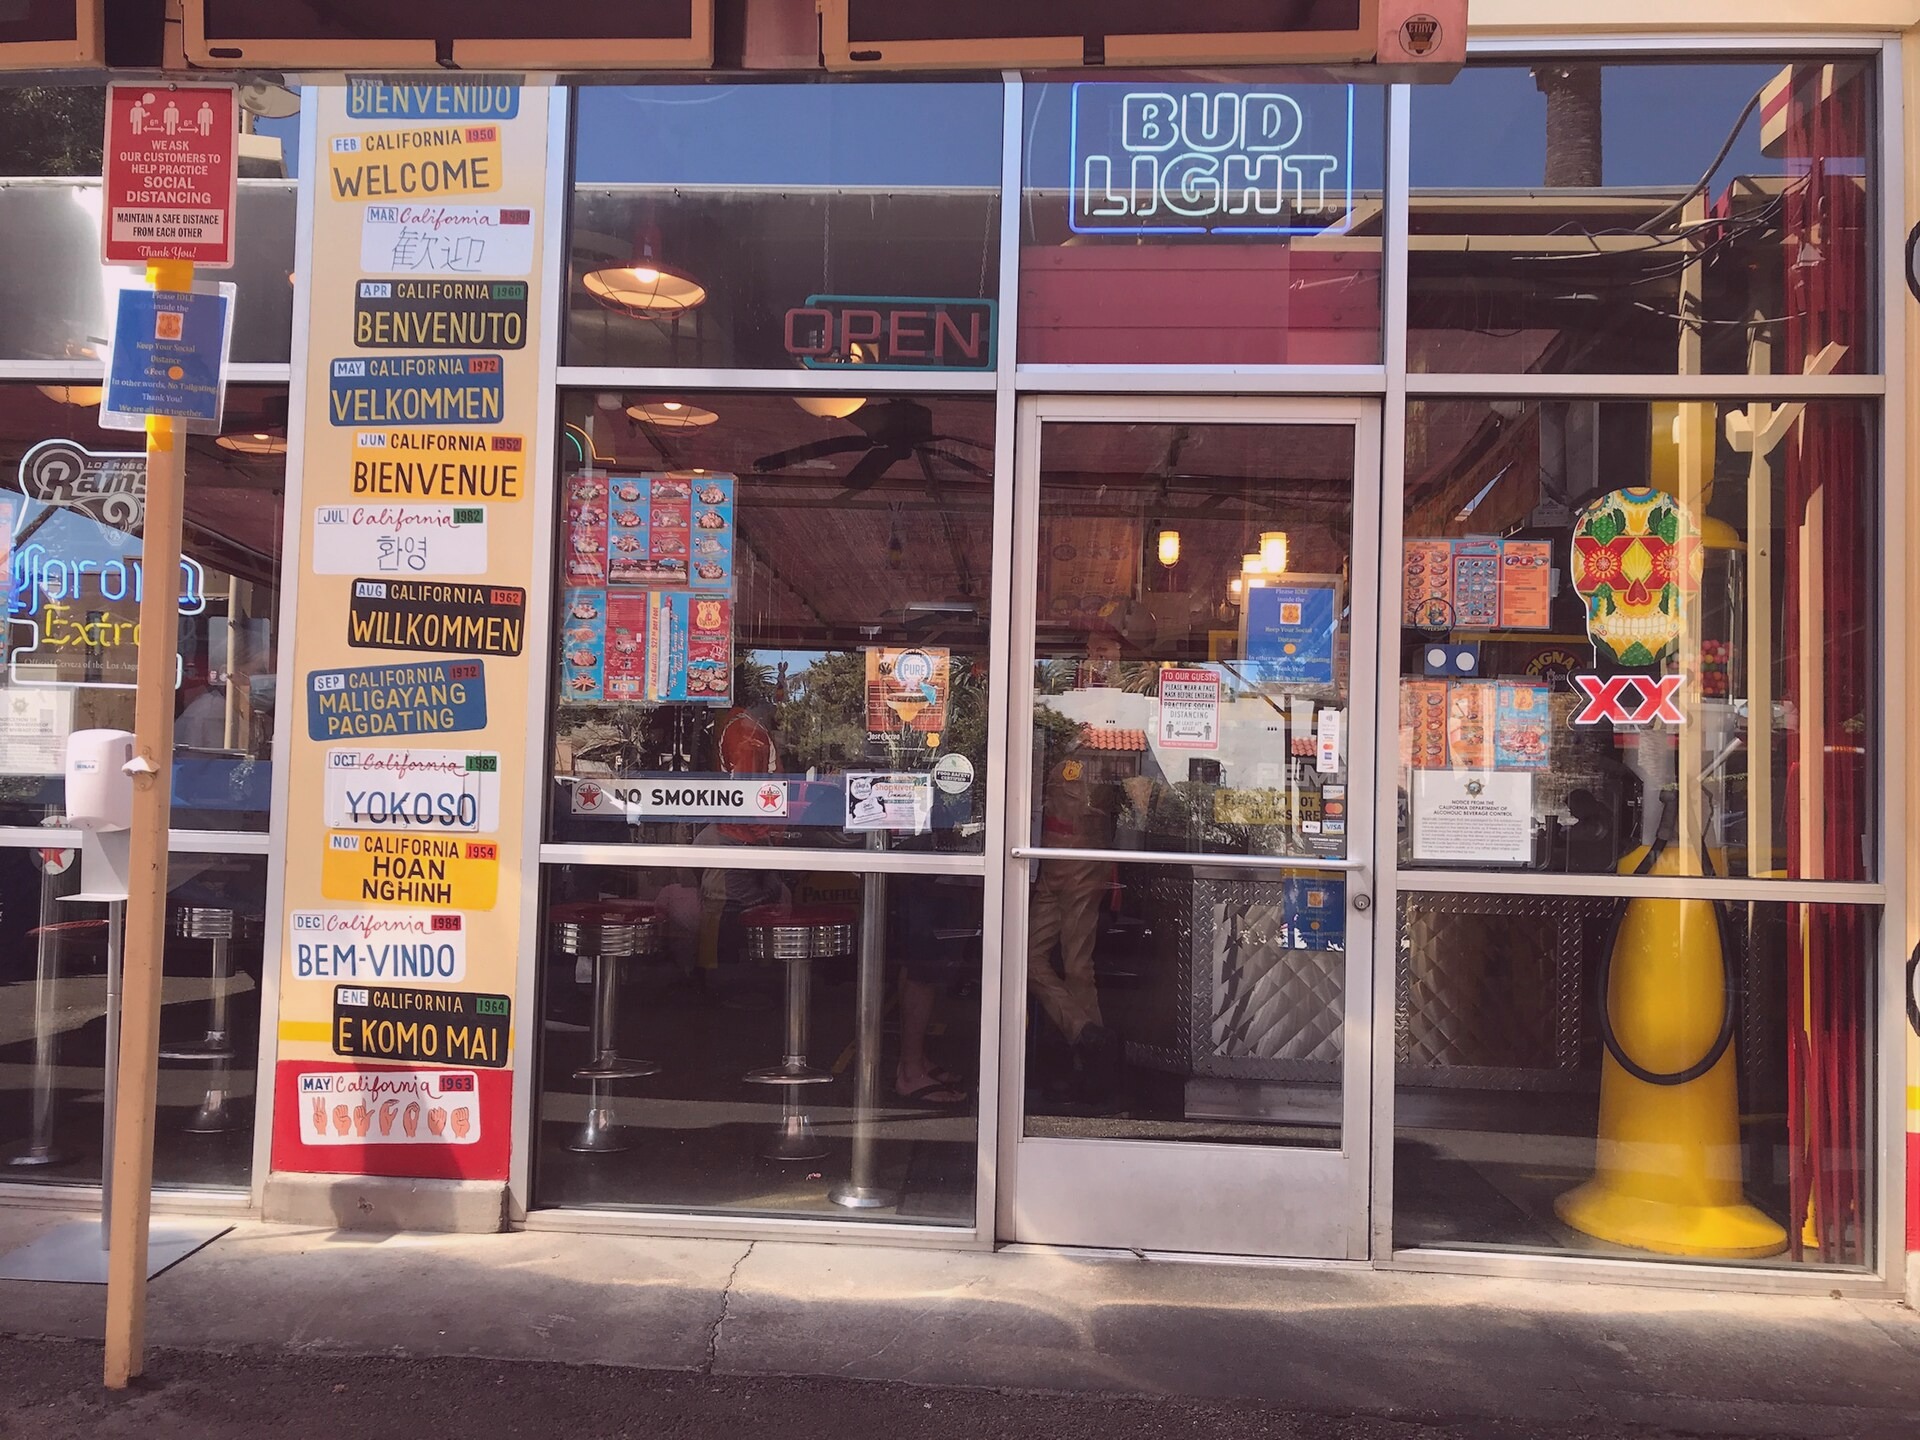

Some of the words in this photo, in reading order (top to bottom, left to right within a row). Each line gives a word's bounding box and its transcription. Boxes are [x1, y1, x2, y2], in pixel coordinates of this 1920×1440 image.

[1408, 22, 1434, 33] ETHYL
[351, 85, 511, 114] BIENVENIDO
[1122, 92, 1303, 152] BUD
[152, 140, 168, 150] WE
[169, 140, 190, 151] ASK
[336, 138, 356, 151] FEB
[366, 129, 462, 152] CALIFORNIA
[468, 129, 494, 141] 1950
[120, 152, 141, 162] OUR
[143, 152, 206, 163] CUSTOMERS
[208, 154, 221, 164] TO
[131, 165, 156, 175] HELP
[159, 165, 208, 176] PRACTICE
[333, 157, 490, 198] WELCOME
[143, 176, 195, 190] SOCIAL
[1084, 152, 1338, 216] LIGHT
[126, 191, 212, 204] DISTANCING
[117, 212, 153, 224] MAINTAIN
[154, 213, 160, 224] A
[162, 214, 180, 224] SAFE
[182, 214, 219, 225] DISTANCE
[370, 208, 395, 222] MAR
[400, 207, 498, 231] California
[132, 226, 154, 236] FROM
[156, 226, 176, 238] EACH
[178, 227, 202, 238] OTHER
[138, 246, 170, 258] Thank
[170, 246, 196, 260] You!
[364, 284, 388, 297] APR
[397, 284, 489, 300] CALIFORNIA
[496, 287, 522, 298] 1960
[176, 304, 189, 312] the
[357, 311, 521, 344] BENVENUTO
[784, 308, 980, 358] OPEN
[136, 341, 153, 351] Keep
[155, 342, 172, 351] Your
[150, 368, 166, 376] Feet
[337, 362, 362, 374] MAY
[369, 358, 464, 376] CALIFORNIA
[472, 360, 496, 372] 1972
[121, 379, 141, 387] other
[142, 392, 164, 401] Thank
[166, 394, 182, 403] You!
[332, 388, 499, 421] VELKOMMEN
[360, 434, 386, 446] JUN
[390, 434, 486, 451] CALIFORNIA
[494, 438, 520, 450] 1952
[87, 461, 110, 469] LOS
[112, 462, 146, 470] ANGE
[354, 461, 518, 498] BIENVENUE
[323, 509, 344, 522] JUL
[352, 508, 460, 532] California
[456, 510, 480, 522] 1982
[376, 535, 428, 571] 환영
[7, 543, 198, 616] Coroa
[358, 584, 383, 597] AUG
[390, 584, 484, 604] CALIFORNIA
[494, 592, 519, 603] 1962
[41, 604, 140, 647] Extr
[352, 610, 520, 652] WILLKOMMEN
[82, 660, 90, 668] of
[92, 660, 104, 669] the
[106, 660, 118, 670] Los
[903, 664, 926, 676] PURE
[1526, 651, 1576, 676] SIGNA
[317, 677, 340, 690] SEP
[349, 666, 446, 688] CALIFORNIA
[452, 666, 476, 678] 1972
[1164, 672, 1173, 680] TO
[1175, 672, 1190, 680] OUR
[1191, 673, 1217, 681] GUESTS
[1202, 684, 1215, 692] FACE
[320, 683, 466, 715] MALIGAYANG
[1164, 702, 1191, 710] PRACTICE
[1194, 692, 1216, 700] ENTERING
[1574, 674, 1688, 725] XX
[328, 708, 454, 736] PAGDATING
[1170, 711, 1209, 719] DISTANCING
[333, 755, 356, 767] OCT
[362, 754, 470, 779] California
[468, 757, 496, 770] 1982
[346, 790, 477, 827] YOKOSO
[614, 788, 642, 804] NO
[652, 788, 744, 806] SMOKING
[1298, 810, 1320, 821] ARE
[333, 836, 358, 849] NOV
[364, 836, 460, 859] CALIFORNIA
[468, 846, 494, 858] 1954
[372, 856, 446, 880] HOAN
[362, 878, 452, 904] NGHINH
[297, 916, 321, 928] DEC
[326, 914, 436, 938] California
[433, 916, 460, 930] 1984
[298, 944, 455, 978] BEM-VINDO
[342, 990, 367, 1004] ENE
[373, 991, 464, 1013] CALIFORNIA
[479, 1000, 504, 1014] 1964
[339, 1017, 354, 1052] E
[361, 1018, 438, 1056] KOMO
[447, 1025, 498, 1062] MAI
[303, 1078, 331, 1091] MAY
[336, 1076, 442, 1102] California
[441, 1076, 472, 1090] 1963
